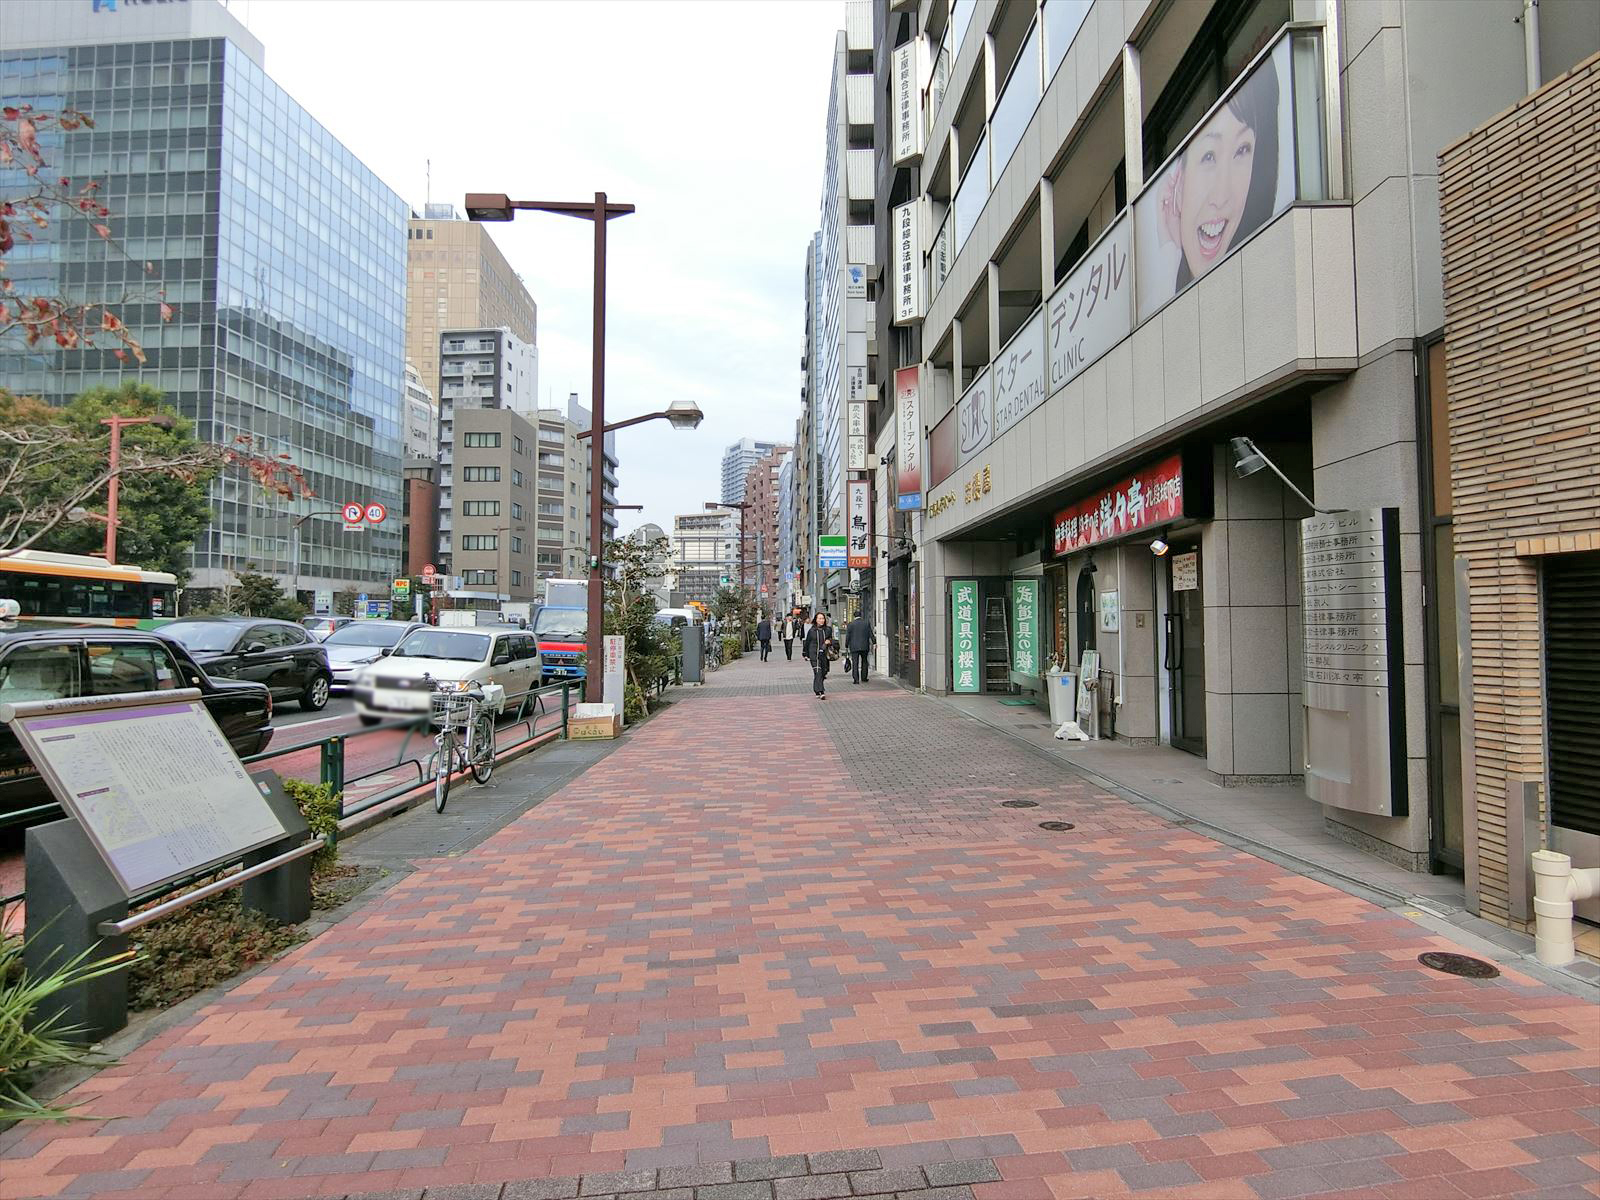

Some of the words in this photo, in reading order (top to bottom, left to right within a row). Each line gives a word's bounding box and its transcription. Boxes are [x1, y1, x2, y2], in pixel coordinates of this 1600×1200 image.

[900, 144, 912, 157] 4F
[902, 207, 913, 307] 九段綜合法律事務所
[901, 306, 914, 319] 3F
[996, 348, 1033, 402] スター
[1051, 242, 1127, 349] デンタル
[996, 401, 1012, 432] STAR
[1014, 375, 1045, 416] DENTAL
[1051, 336, 1086, 385] CLINIC
[906, 400, 916, 473] スターデンタル
[368, 508, 381, 518] 40
[855, 488, 863, 510] 九段下
[1100, 478, 1145, 537] 洋々亭
[957, 586, 975, 688] 武道具の櫻屋
